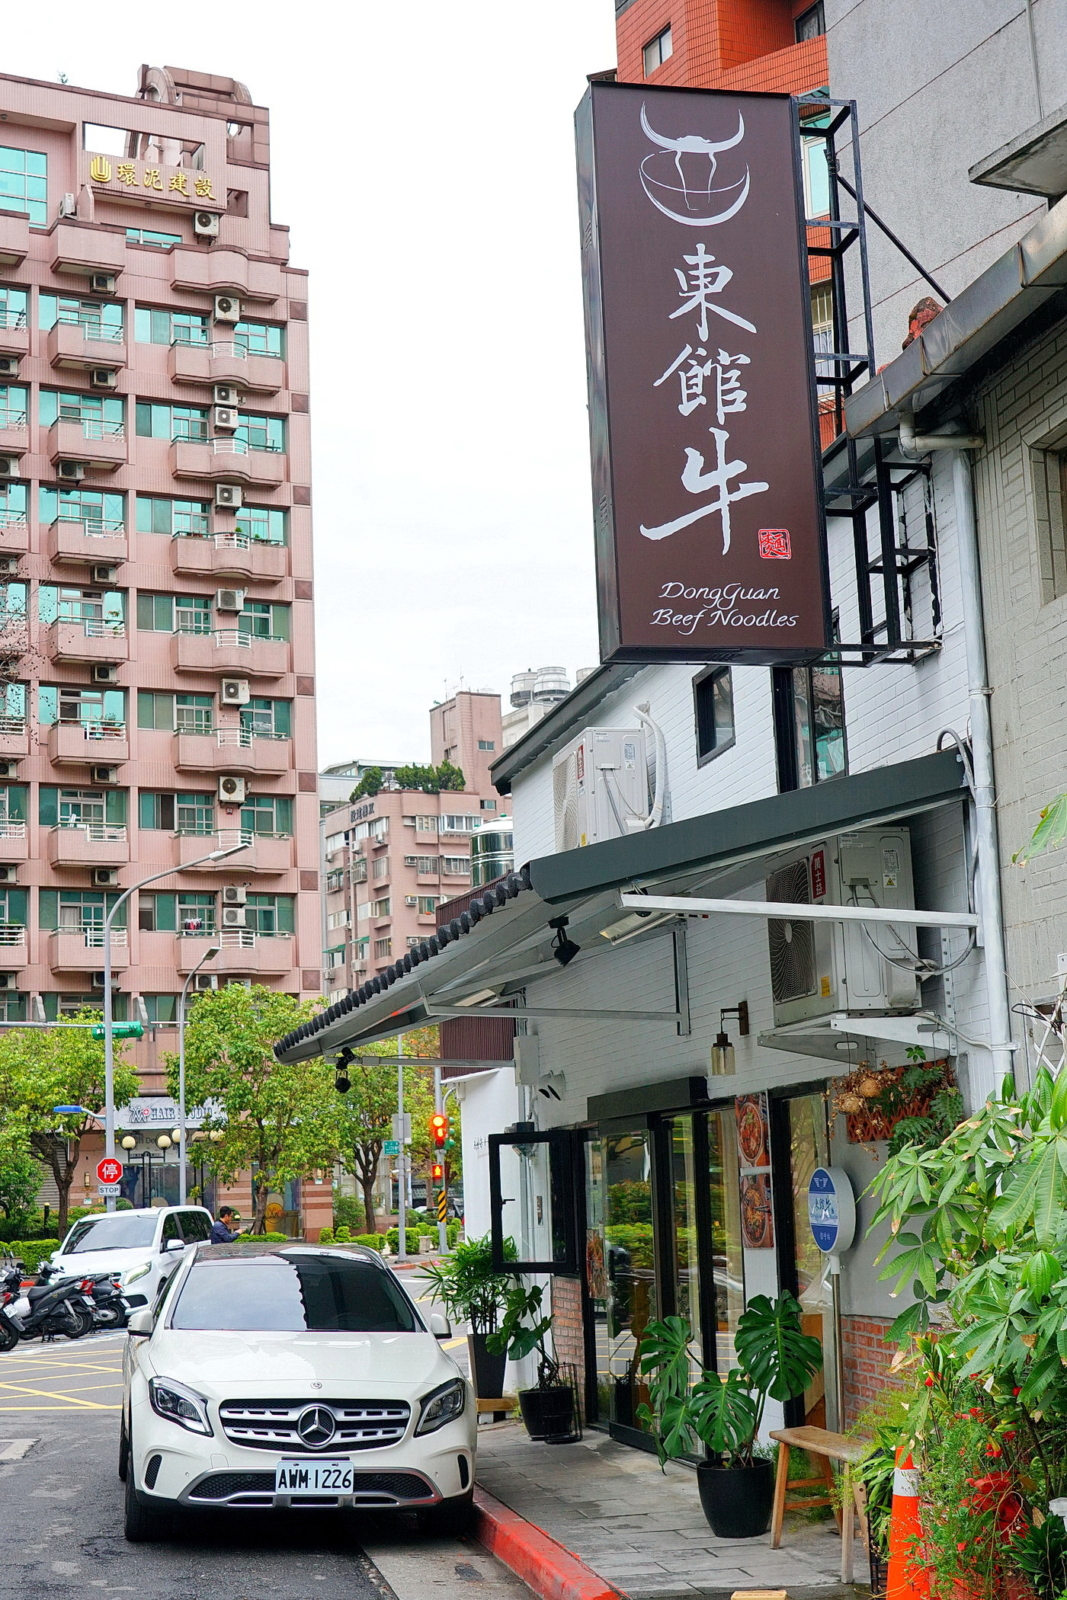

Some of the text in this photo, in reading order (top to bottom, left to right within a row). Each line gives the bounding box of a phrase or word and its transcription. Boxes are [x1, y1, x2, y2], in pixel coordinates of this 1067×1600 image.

[117, 163, 216, 201] 環泥建設
[658, 581, 781, 610] DongGuan
[649, 608, 800, 636] Beef Noodles
[151, 1107, 176, 1121] HAIR
[102, 1163, 118, 1179] 停
